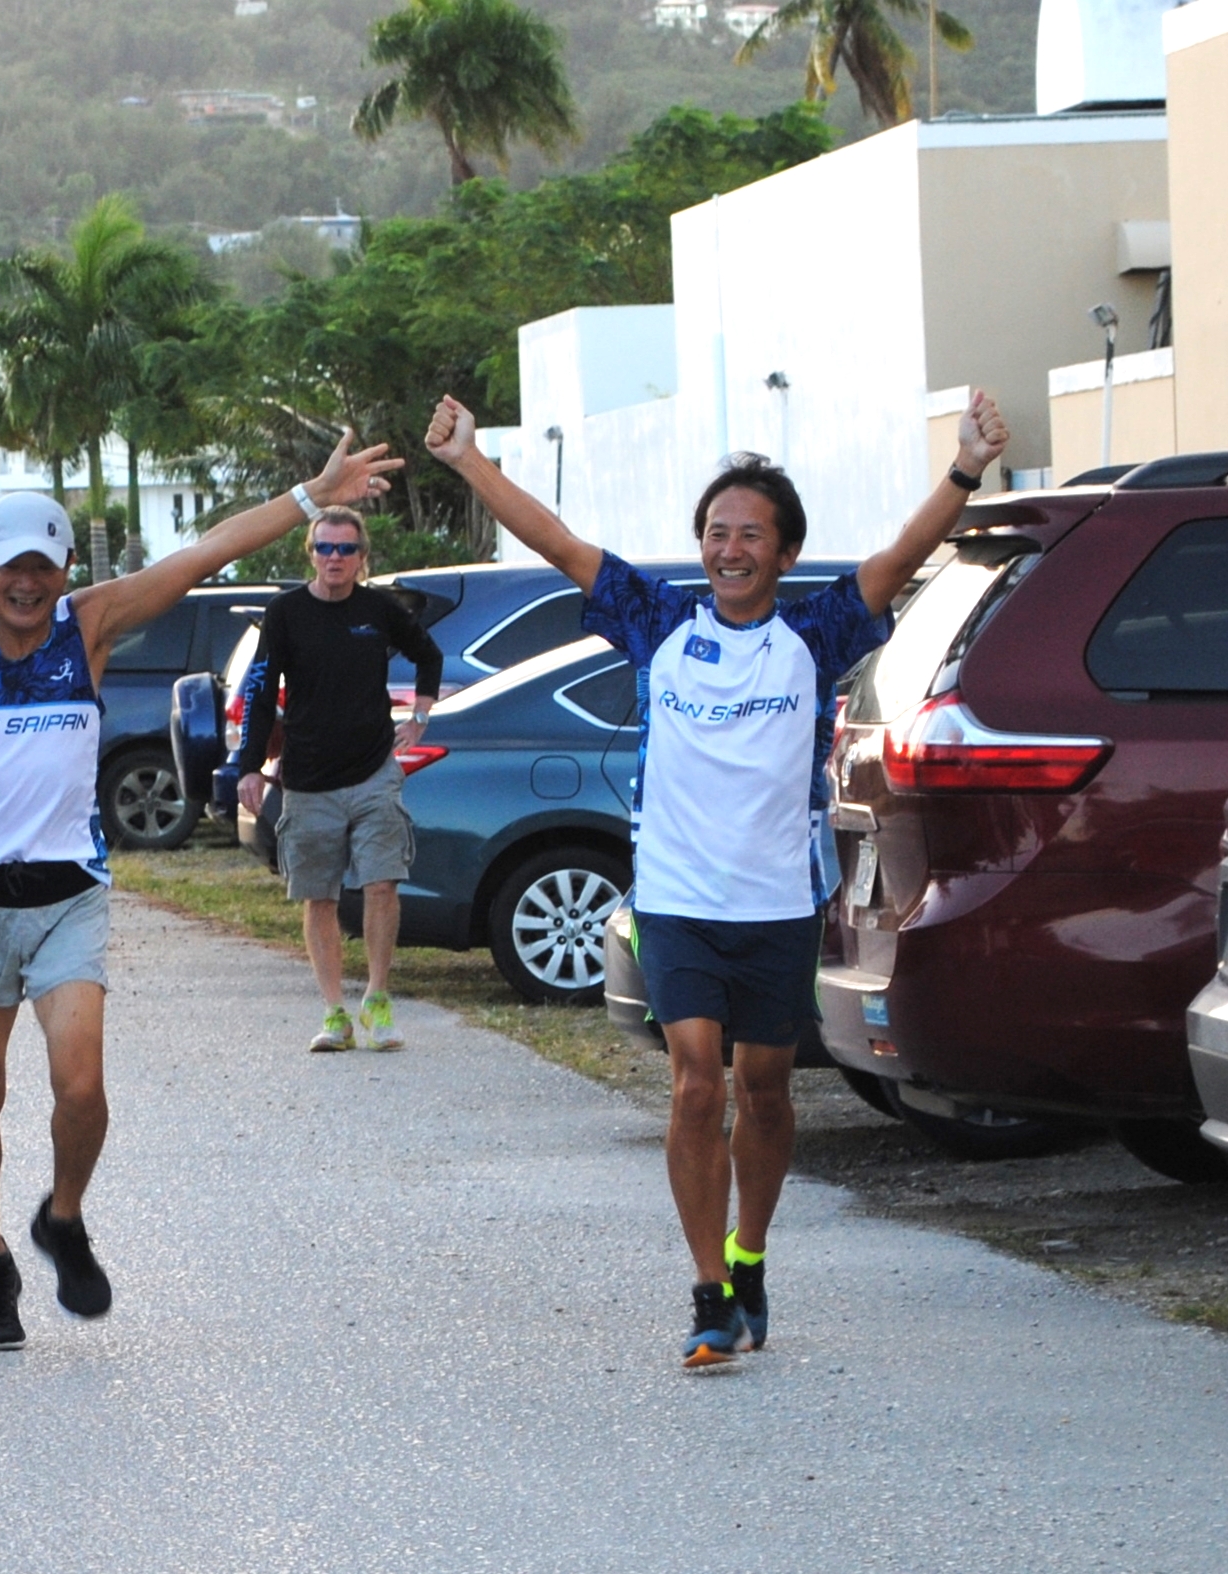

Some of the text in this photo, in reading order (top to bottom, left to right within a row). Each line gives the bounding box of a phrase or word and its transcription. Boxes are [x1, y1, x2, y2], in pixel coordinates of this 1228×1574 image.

[659, 690, 800, 721] RUN SAIPAN
[4, 713, 90, 735] SAIPAN
